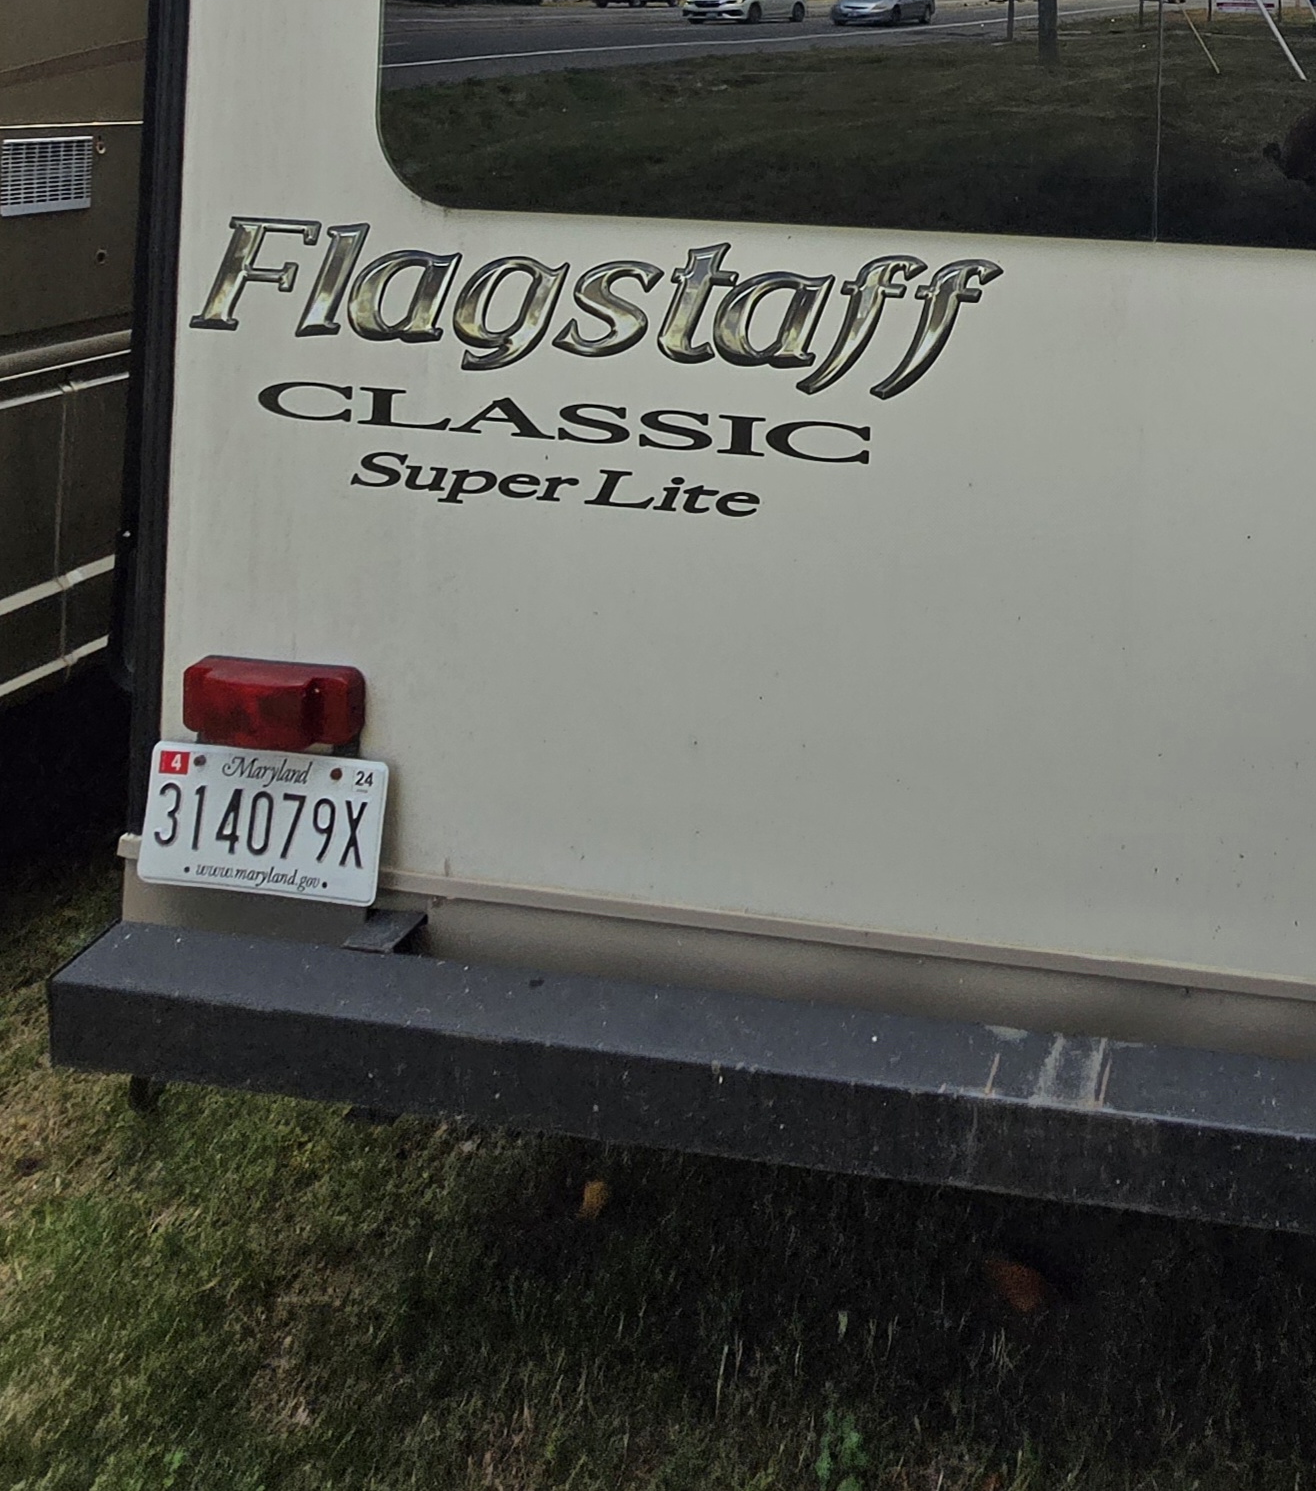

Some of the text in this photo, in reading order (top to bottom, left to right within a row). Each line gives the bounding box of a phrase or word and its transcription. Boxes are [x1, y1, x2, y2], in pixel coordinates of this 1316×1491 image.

[189, 216, 1003, 400] Flagstaff
[257, 381, 872, 464] CLASSIC
[351, 451, 762, 517] Super Lite
[171, 753, 182, 771] 4
[222, 756, 313, 787] Maryland
[355, 770, 374, 787] 24
[154, 782, 368, 869] 314079X
[195, 864, 321, 891] www.maryland.gov
